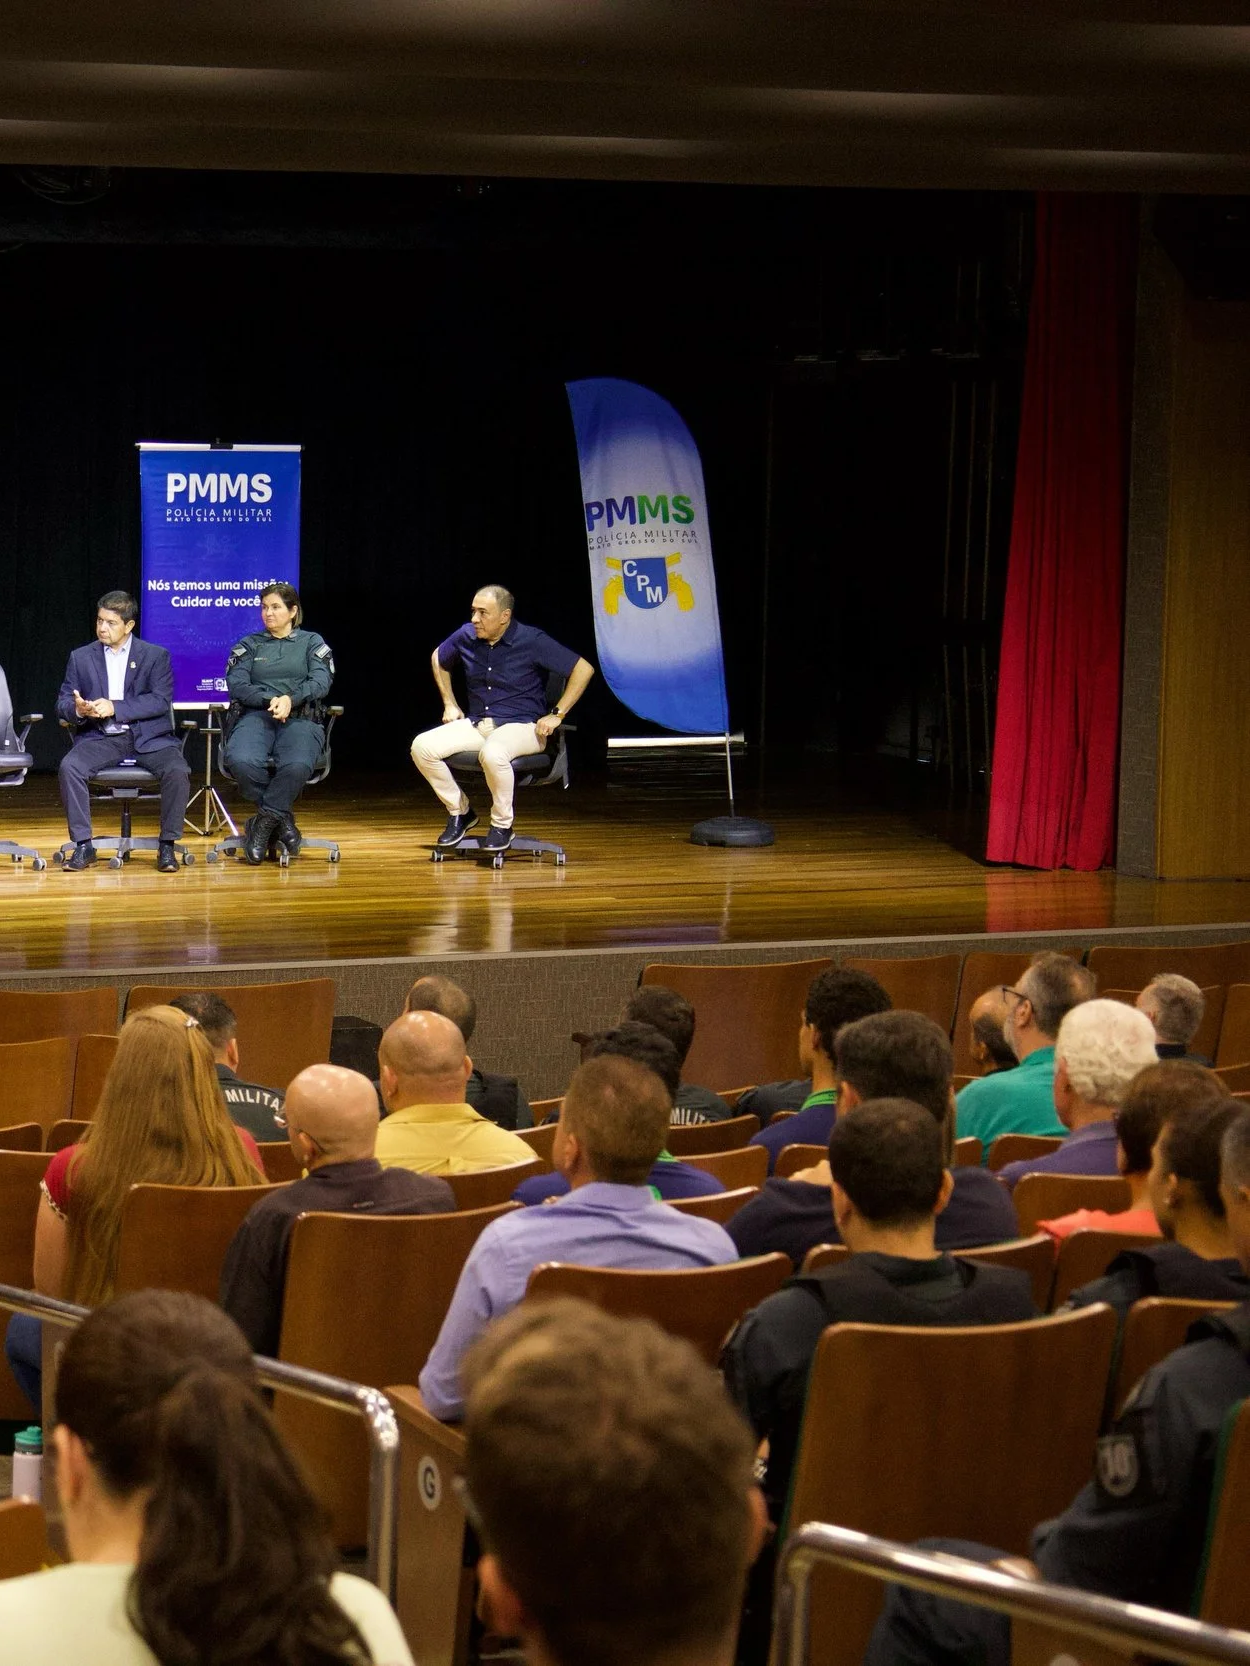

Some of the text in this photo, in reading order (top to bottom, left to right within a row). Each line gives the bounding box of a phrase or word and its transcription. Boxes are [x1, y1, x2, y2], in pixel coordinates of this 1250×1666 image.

[166, 472, 272, 503] PMMS
[166, 507, 272, 516] POLÍCIA MILITAR
[584, 494, 695, 532] PMMS
[644, 530, 697, 538] MILITAR
[148, 580, 170, 590] Nós
[173, 580, 211, 590] temos
[214, 581, 240, 590] uma
[171, 595, 261, 607] Cuidar de você
[225, 1089, 280, 1111] MILITA
[670, 1107, 710, 1125] MILIT
[424, 1466, 435, 1498] G
